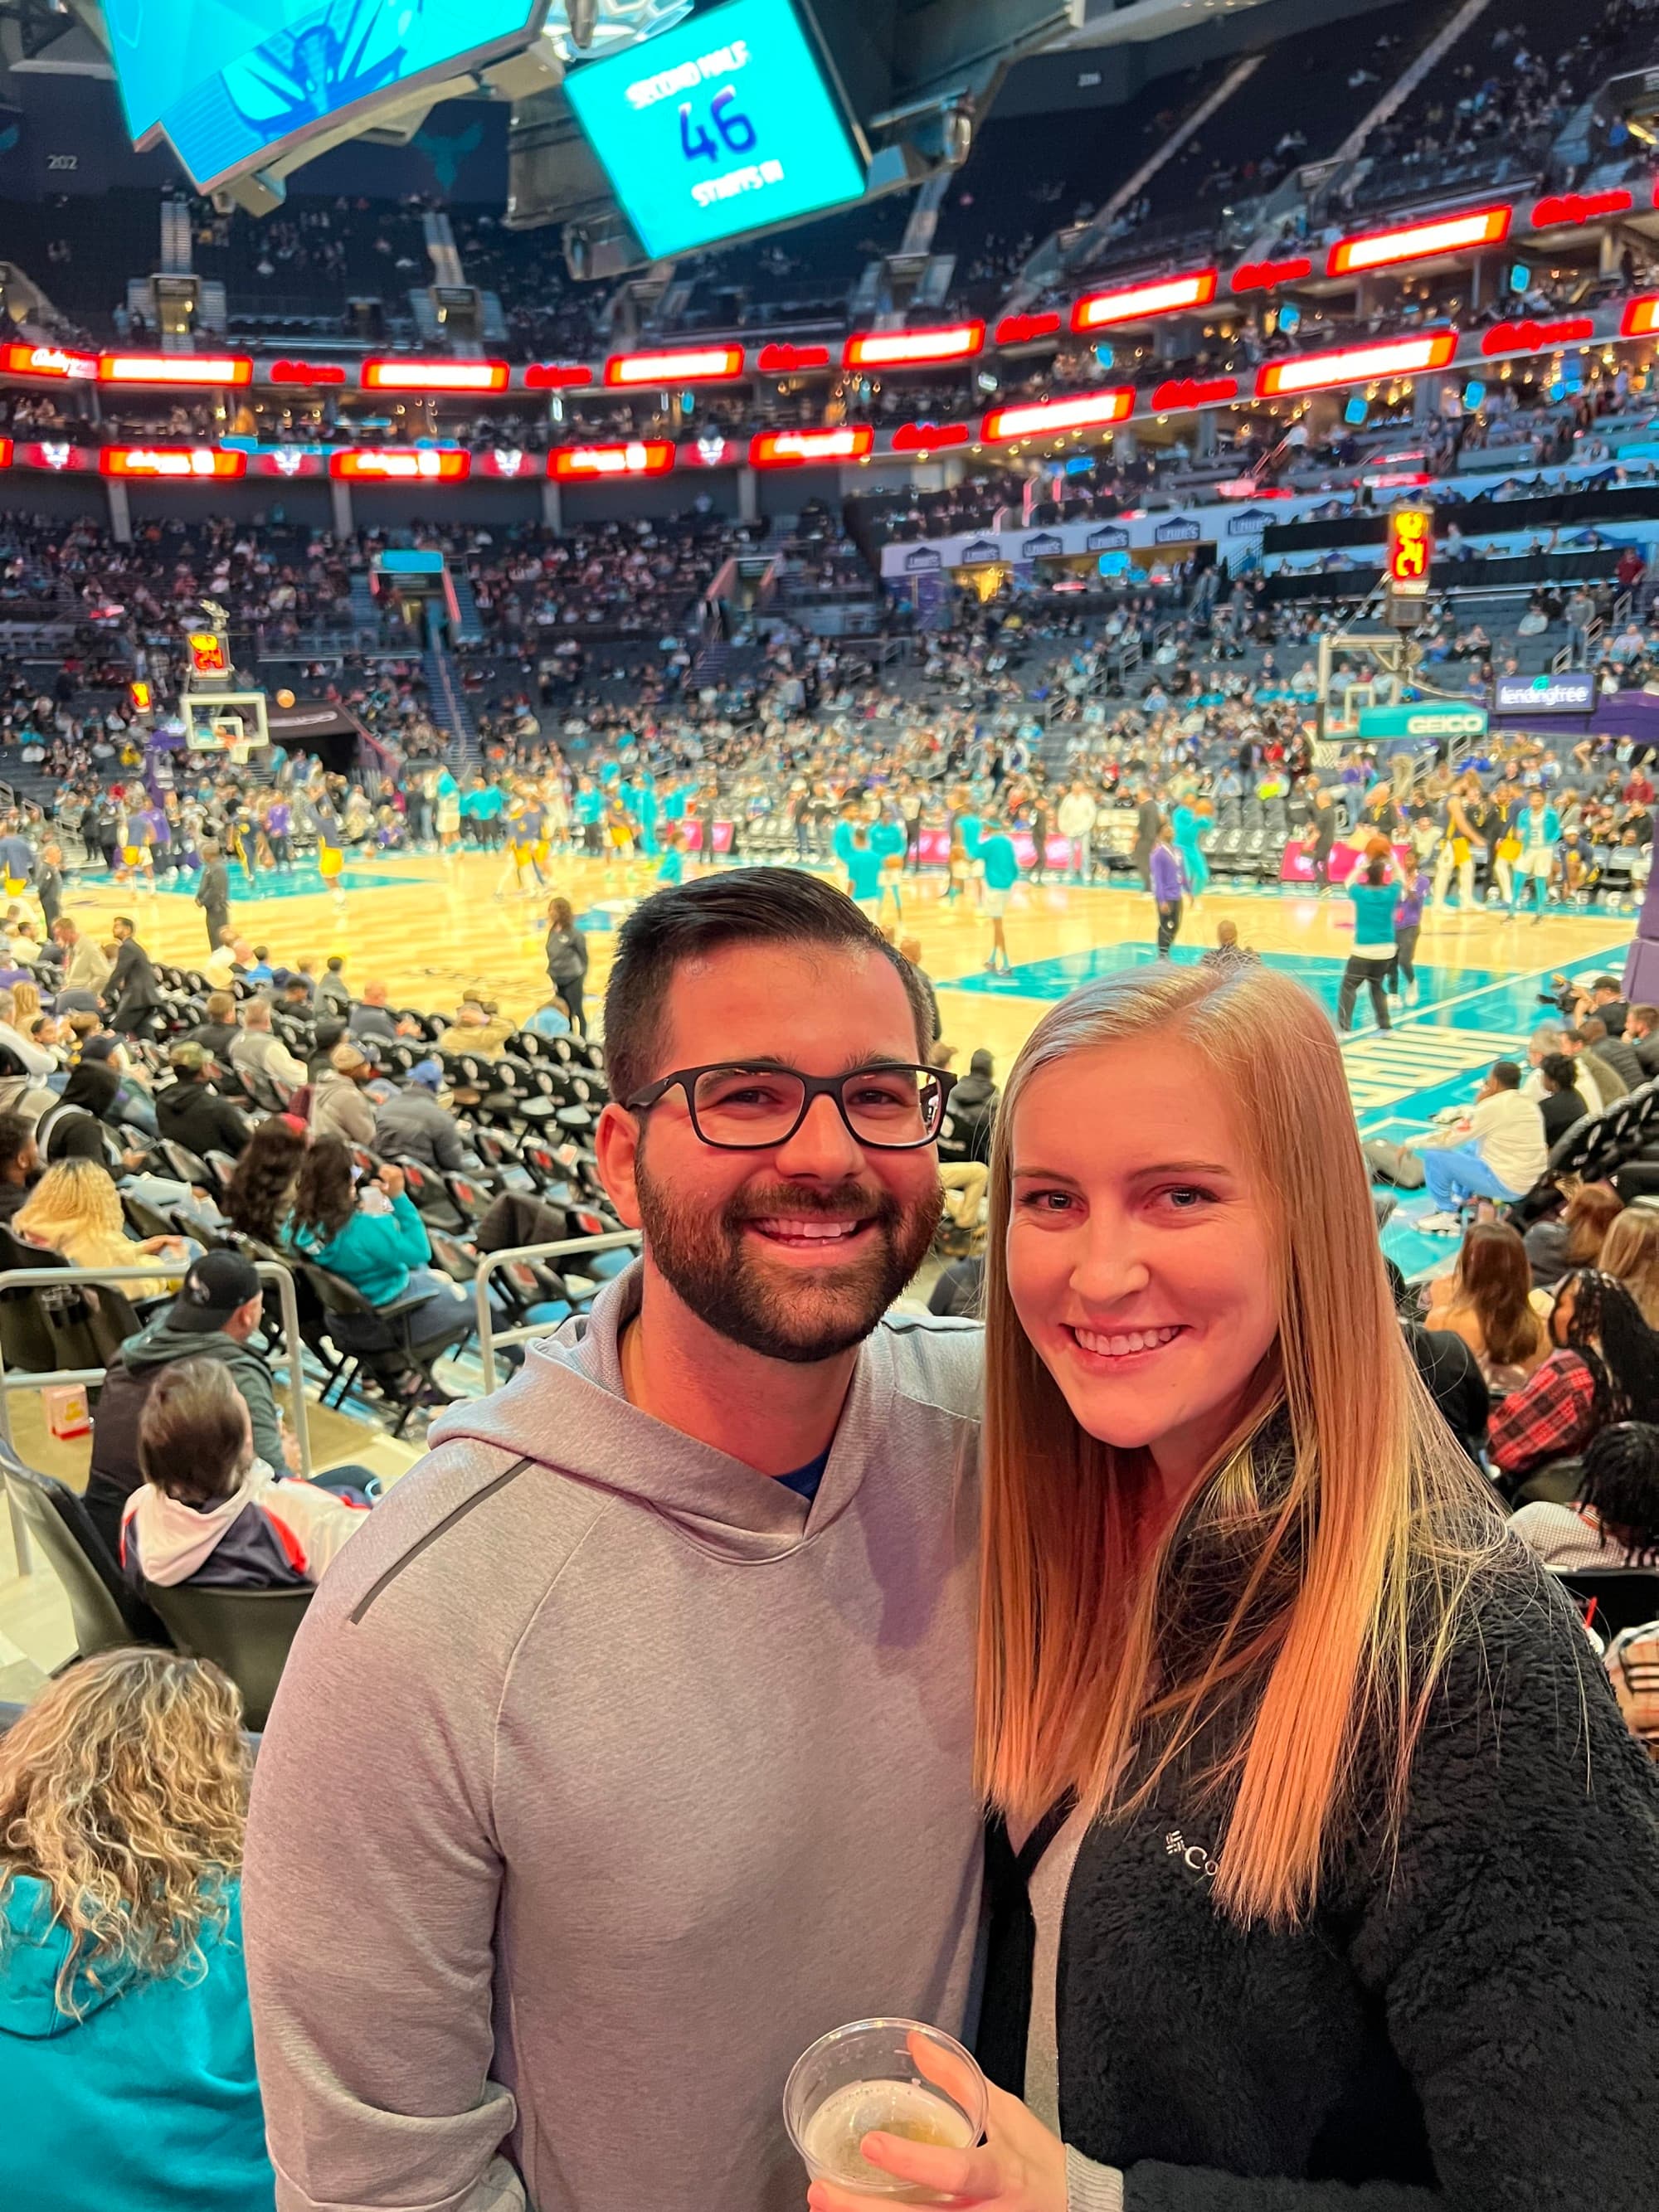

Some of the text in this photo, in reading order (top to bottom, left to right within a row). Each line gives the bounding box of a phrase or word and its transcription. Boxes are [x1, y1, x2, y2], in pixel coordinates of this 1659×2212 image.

[679, 84, 757, 163] 46
[47, 155, 78, 170] 202
[1407, 715, 1483, 734] GEICO
